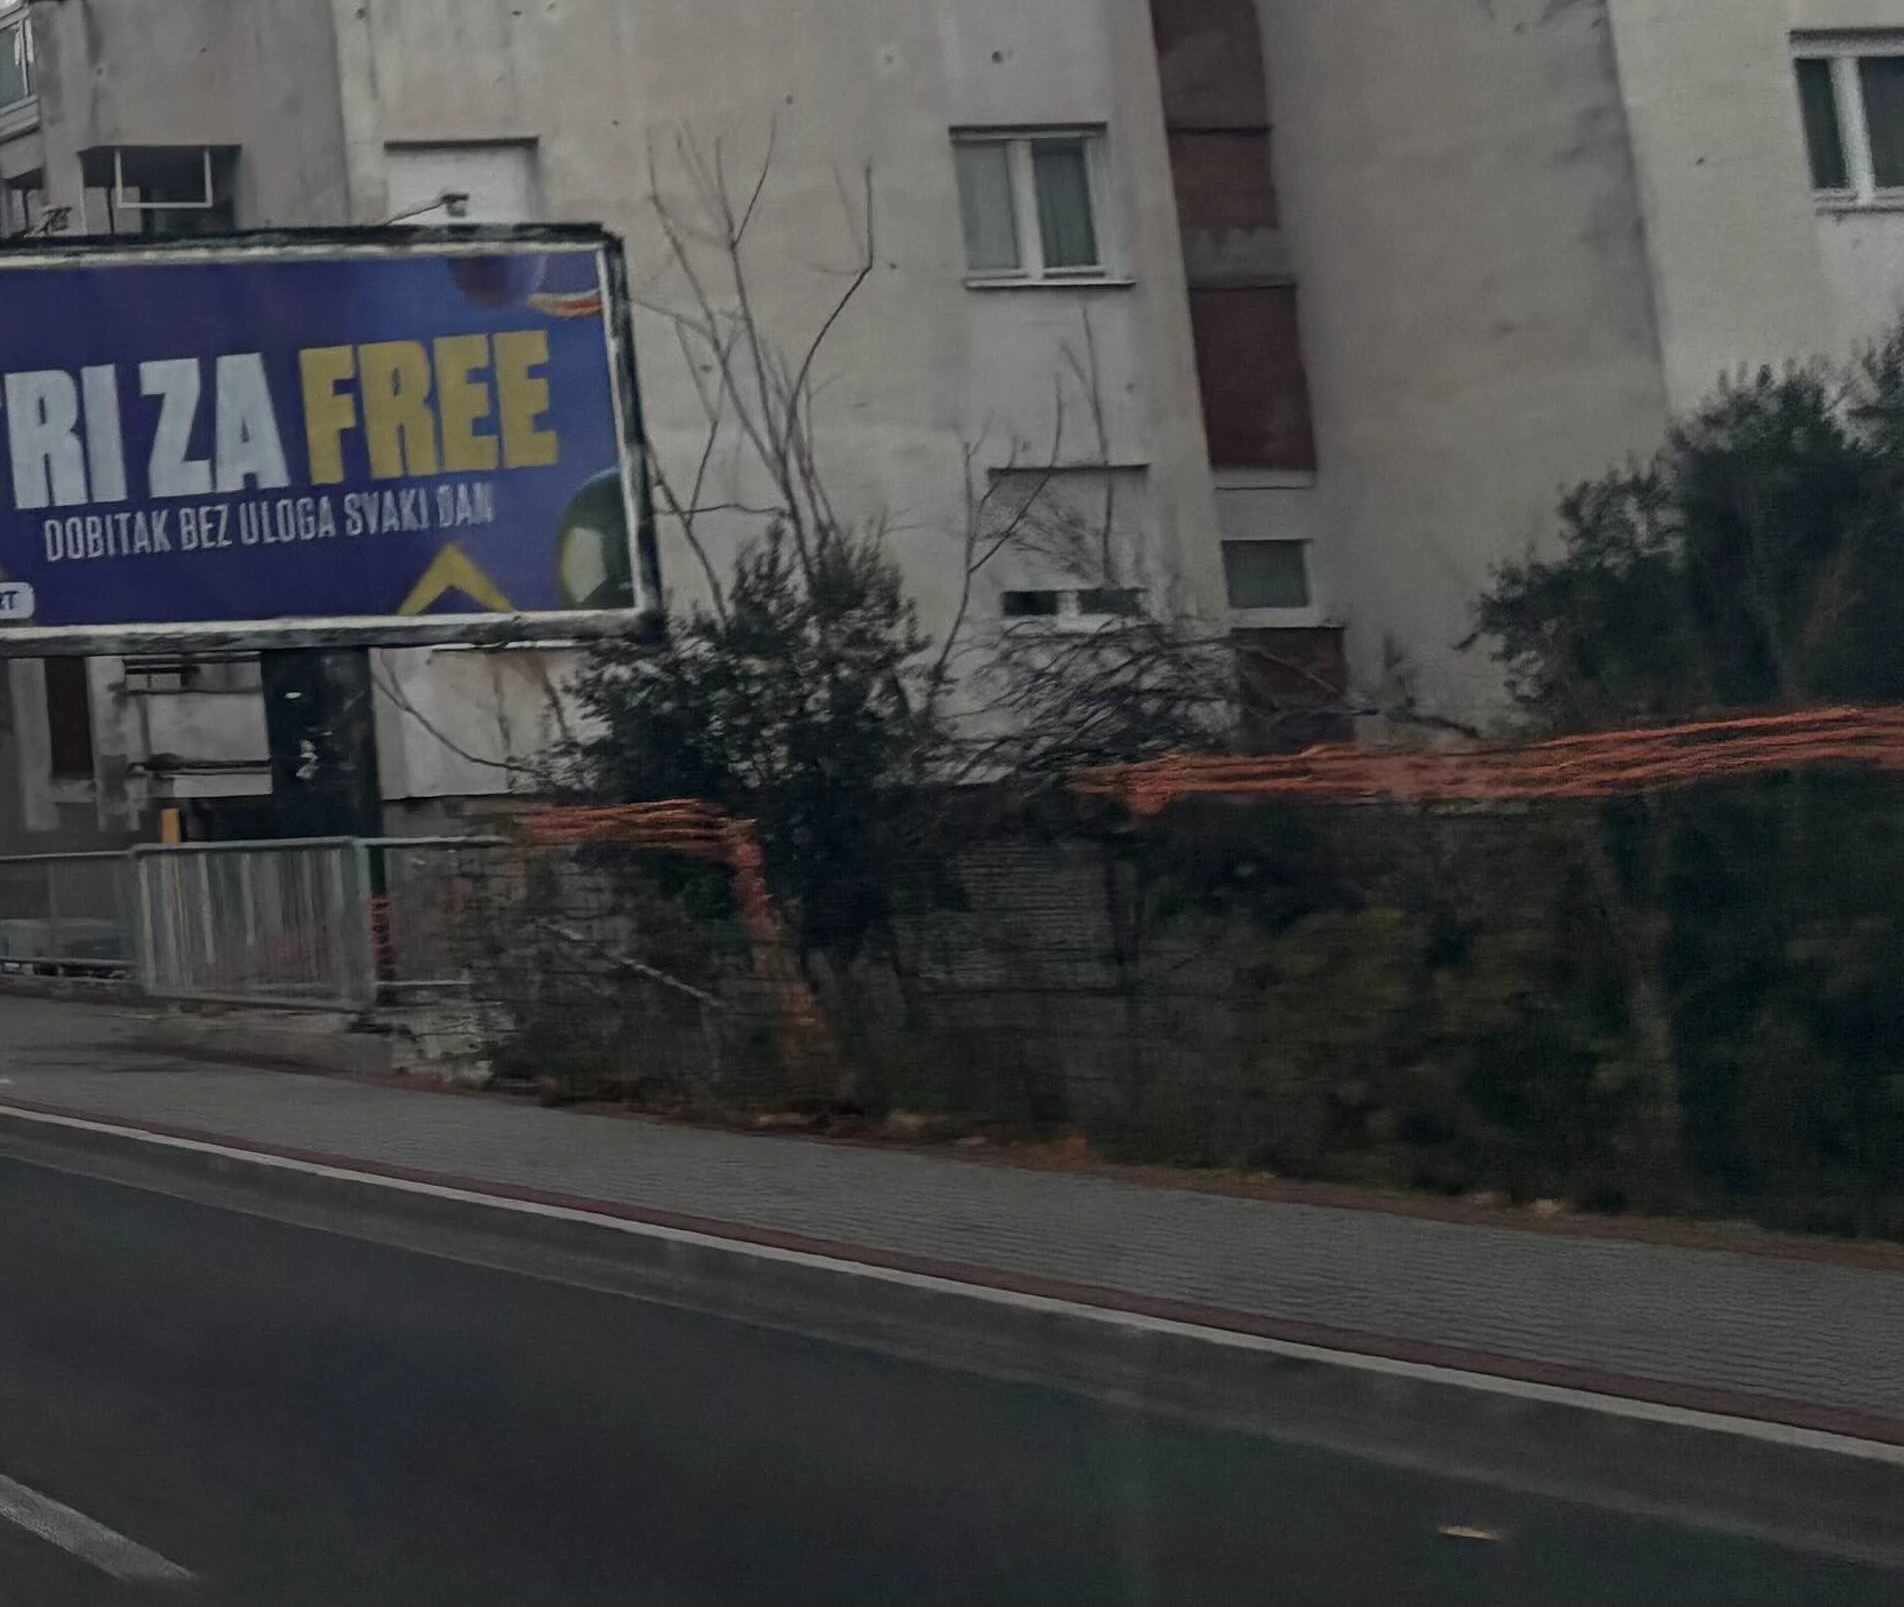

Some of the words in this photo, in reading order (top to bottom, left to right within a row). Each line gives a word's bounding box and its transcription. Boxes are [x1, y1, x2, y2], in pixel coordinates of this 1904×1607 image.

[139, 353, 290, 499] ZA
[298, 330, 559, 486] FREE
[45, 505, 173, 563] DOBITAK
[179, 504, 232, 551] BEZ
[239, 498, 336, 546] ULOGA
[344, 492, 430, 537] SVAKI
[438, 482, 495, 528] DAN
